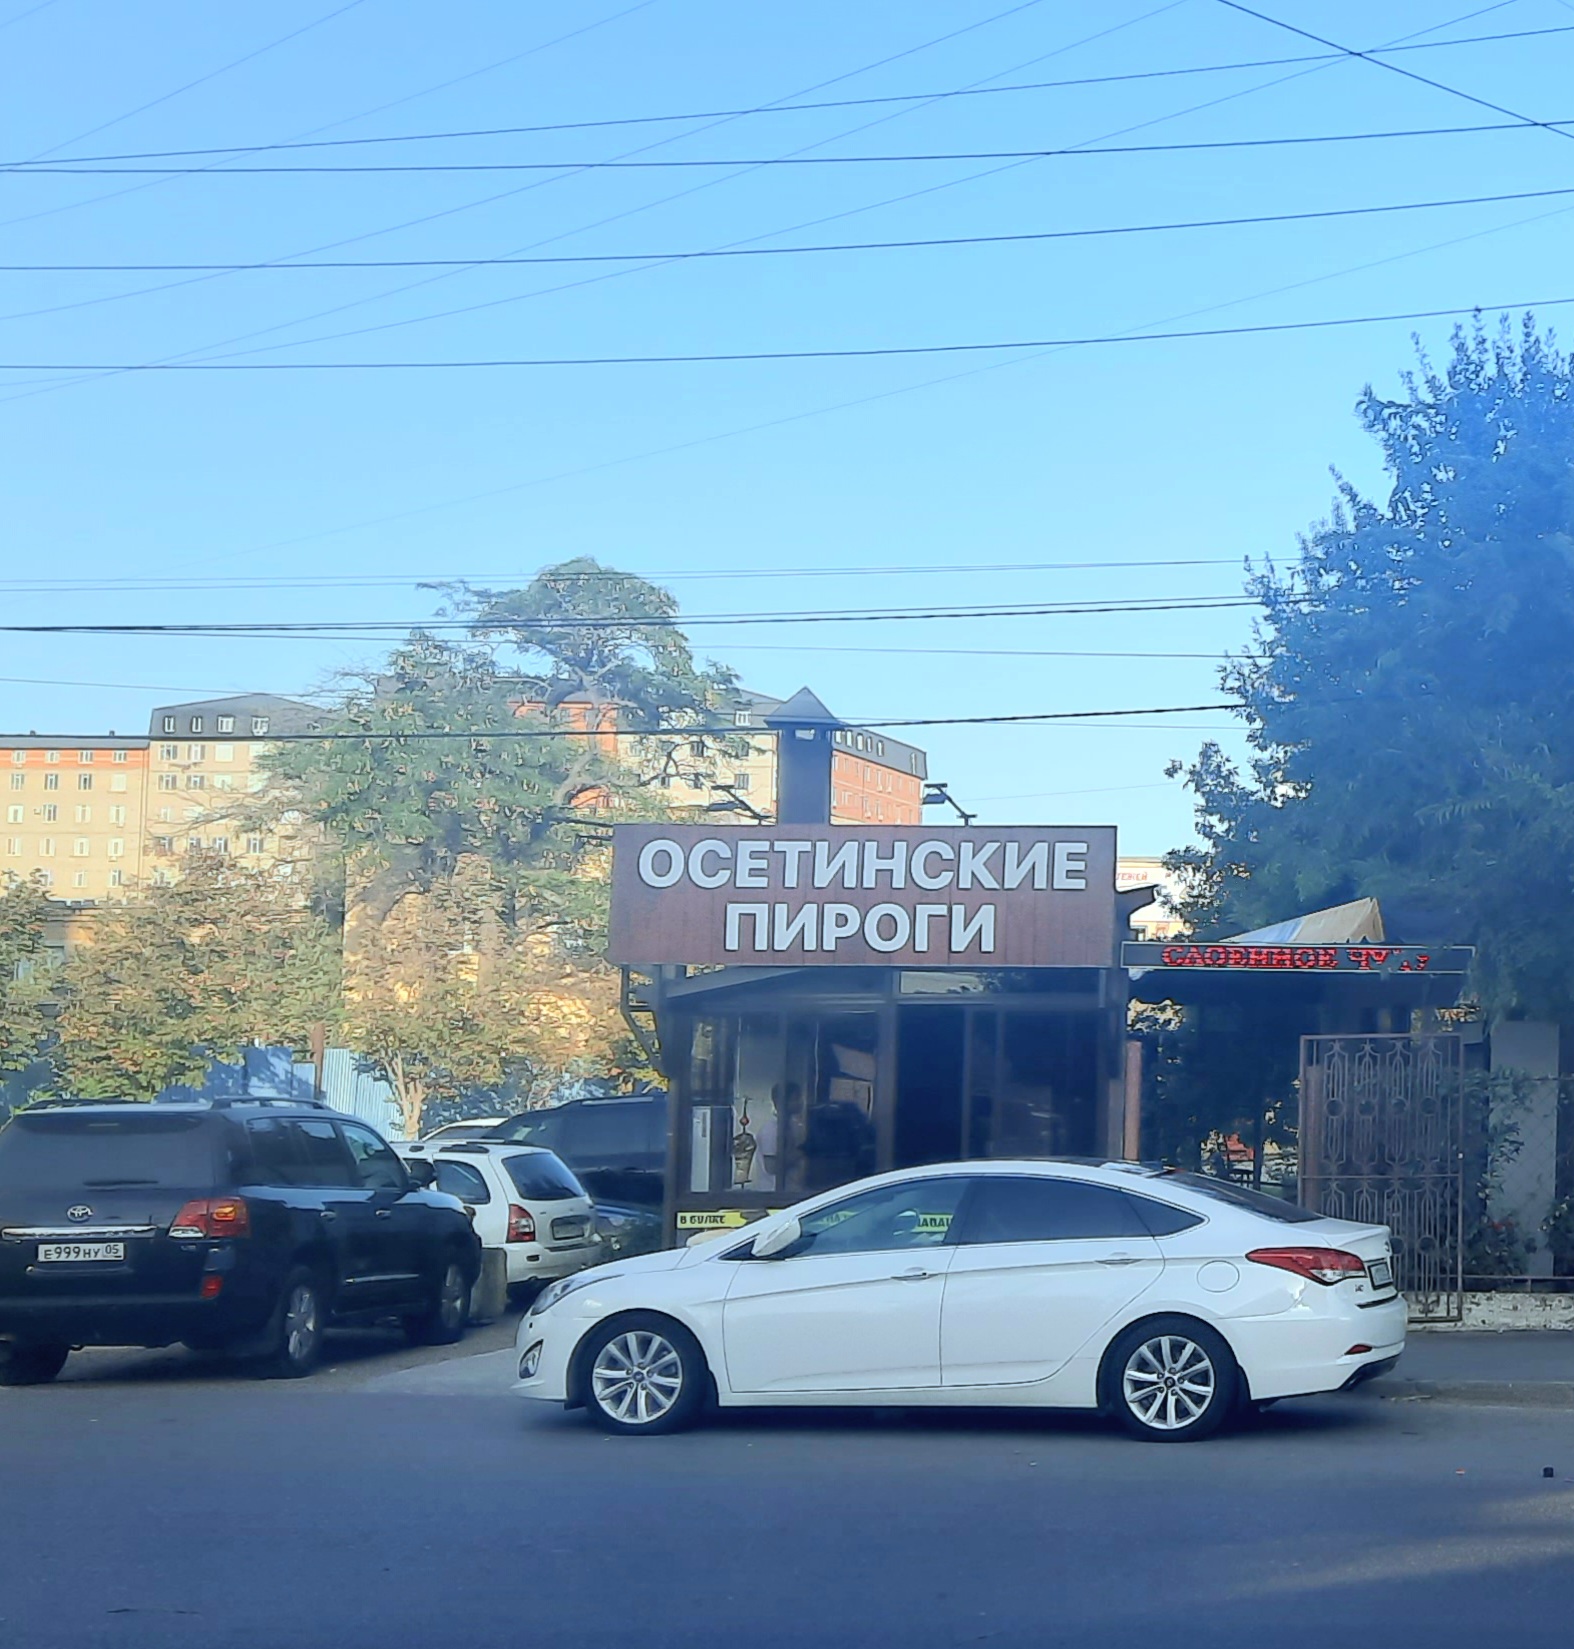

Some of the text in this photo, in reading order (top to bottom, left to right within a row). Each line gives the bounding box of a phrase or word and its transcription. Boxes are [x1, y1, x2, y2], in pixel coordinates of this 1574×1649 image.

[637, 838, 1089, 891] ОСЕТИНСКИЕ
[724, 902, 996, 953] ПИРОГИ
[680, 1215, 687, 1225] В
[105, 1244, 119, 1255] 05
